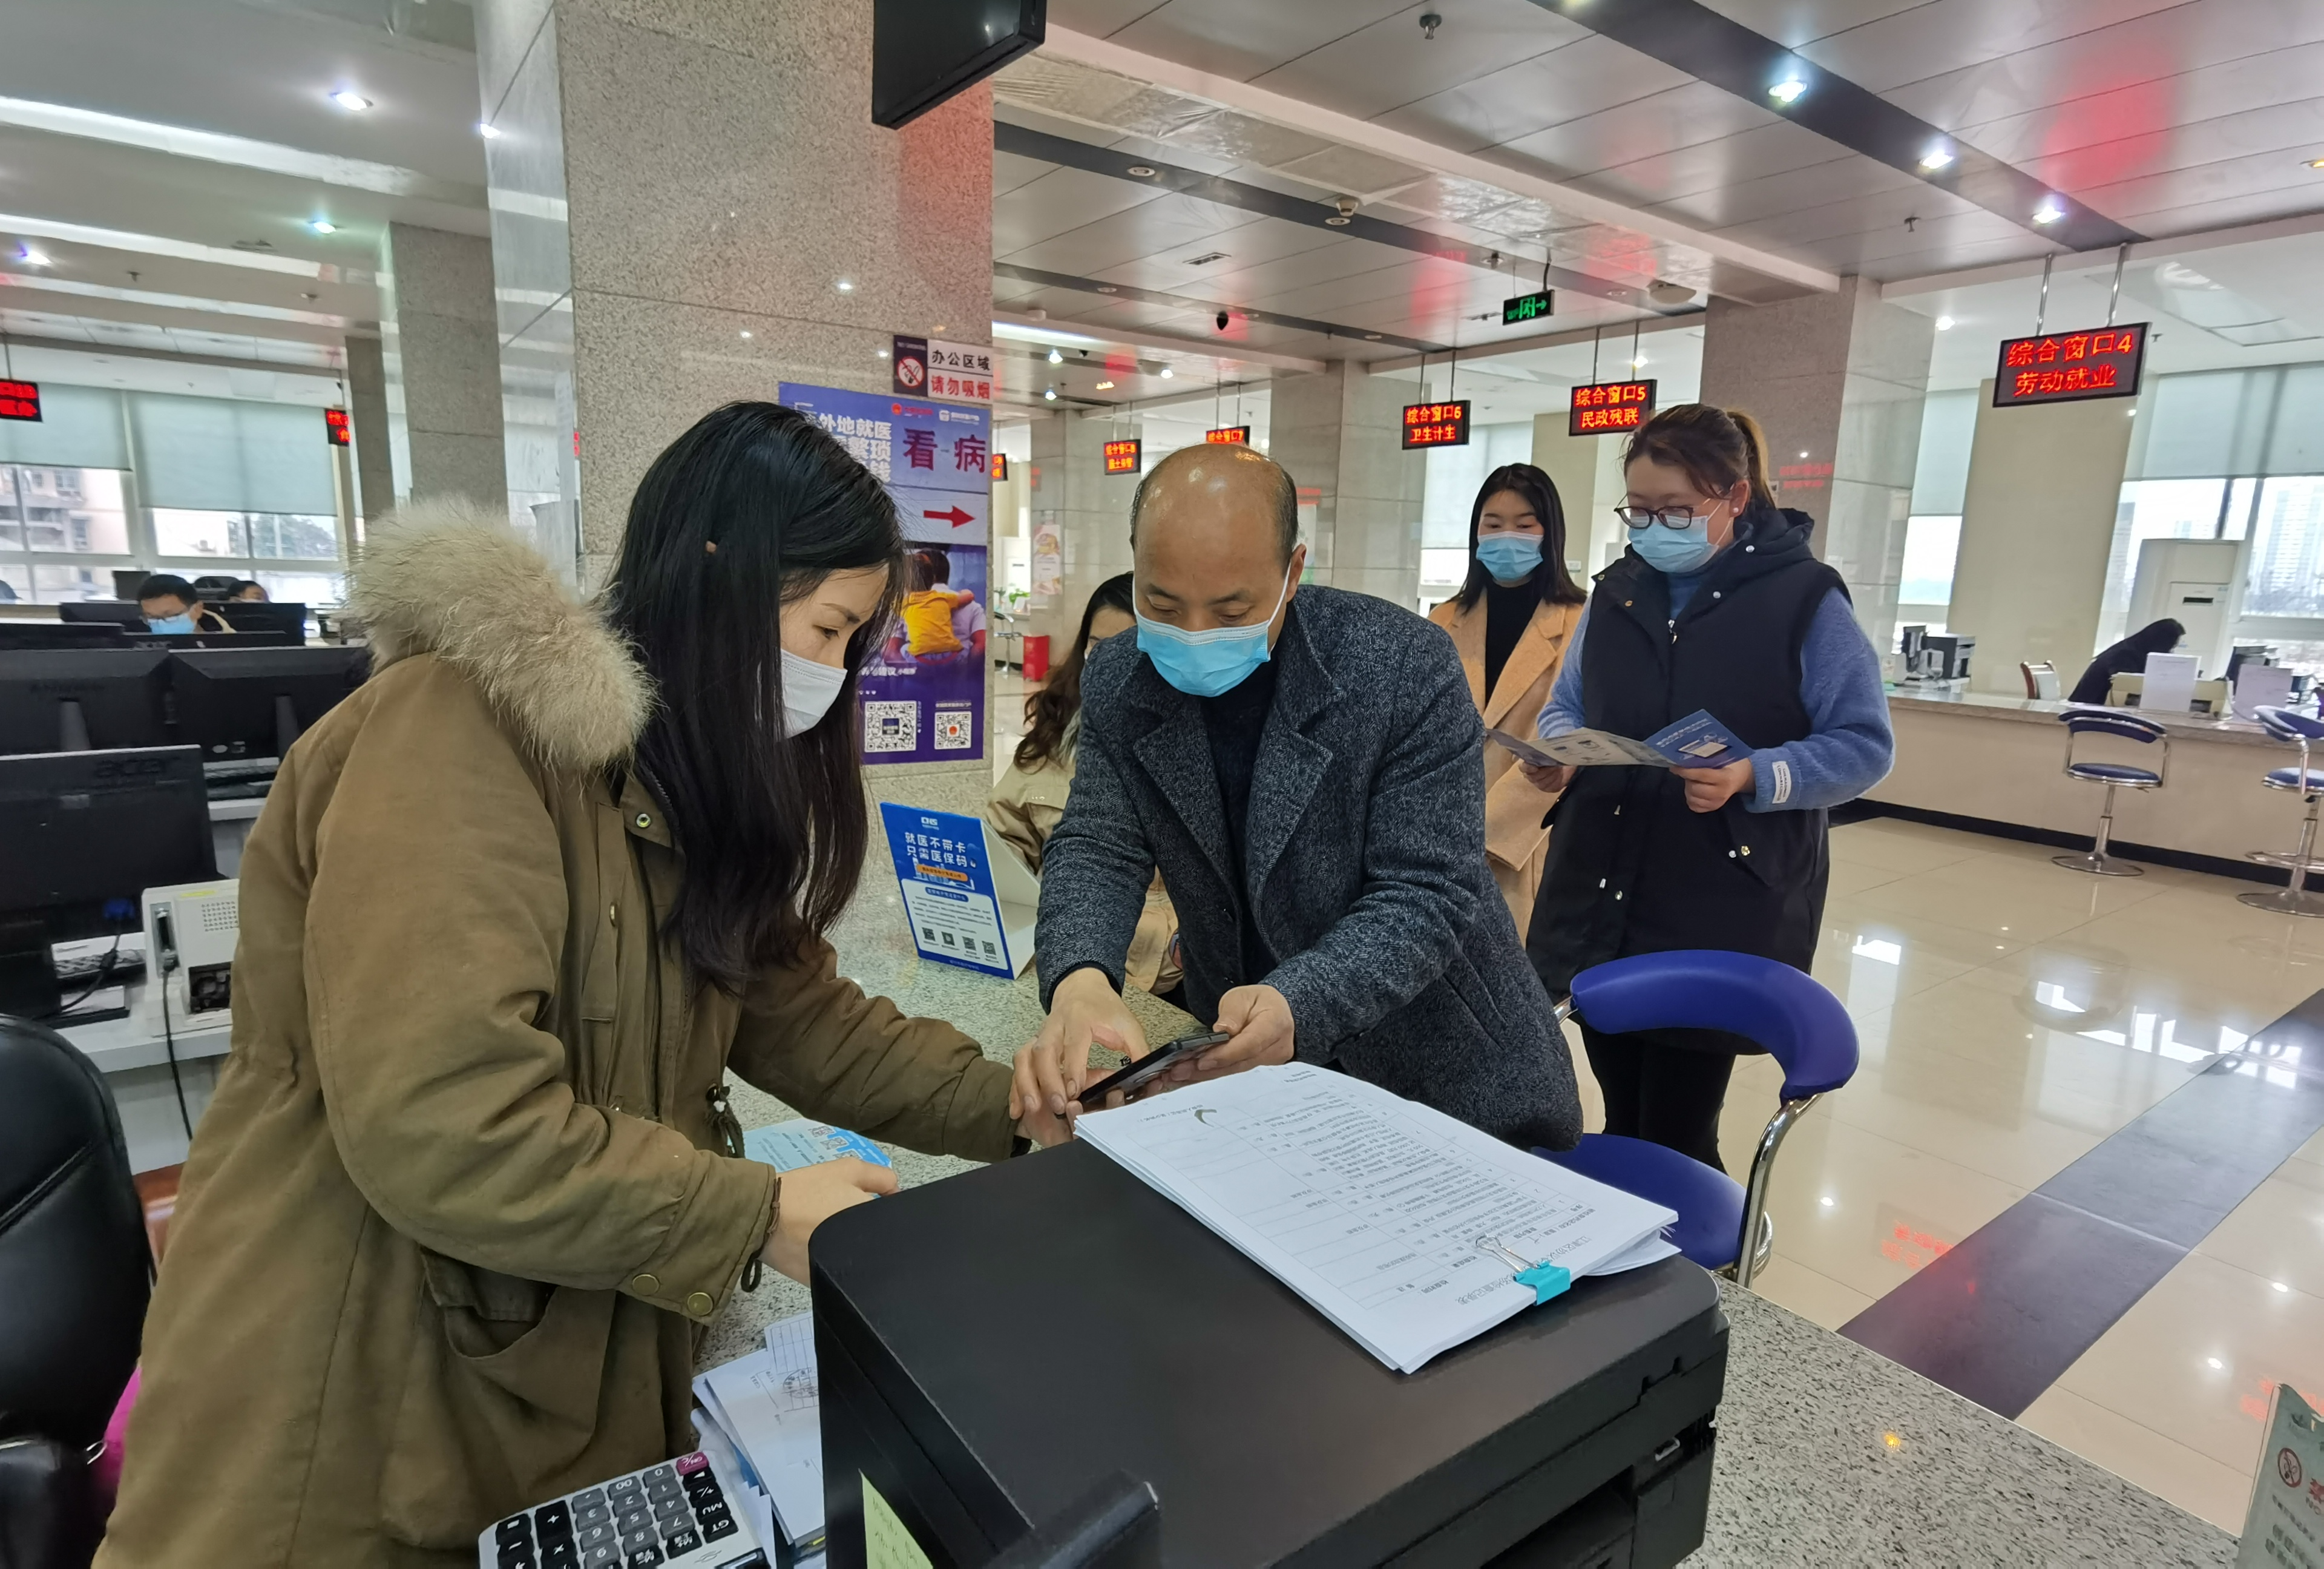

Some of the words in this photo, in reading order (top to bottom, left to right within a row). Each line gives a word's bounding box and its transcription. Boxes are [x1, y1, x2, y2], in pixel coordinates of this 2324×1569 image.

[2006, 332, 2133, 367] 综合窗口4
[932, 349, 990, 371] 办公区域
[931, 375, 990, 400] 请勿吸烟
[2013, 364, 2116, 396] 劳动就业
[1575, 385, 1647, 407] 综合窗口5
[1405, 405, 1462, 424] 综合窗口6
[1581, 407, 1639, 429] 民政残联
[1409, 424, 1456, 442] 卫生计生
[905, 832, 967, 854] 就医不带卡
[907, 846, 968, 867] 只需医保码
[655, 1468, 663, 1476] 0
[615, 1479, 632, 1490] 00
[625, 1495, 634, 1505] 2
[666, 1500, 675, 1508] 4
[703, 1502, 723, 1515] MU
[630, 1513, 639, 1524] 5
[673, 1517, 682, 1527] 7
[711, 1519, 729, 1533] GT
[634, 1531, 644, 1542] 8
